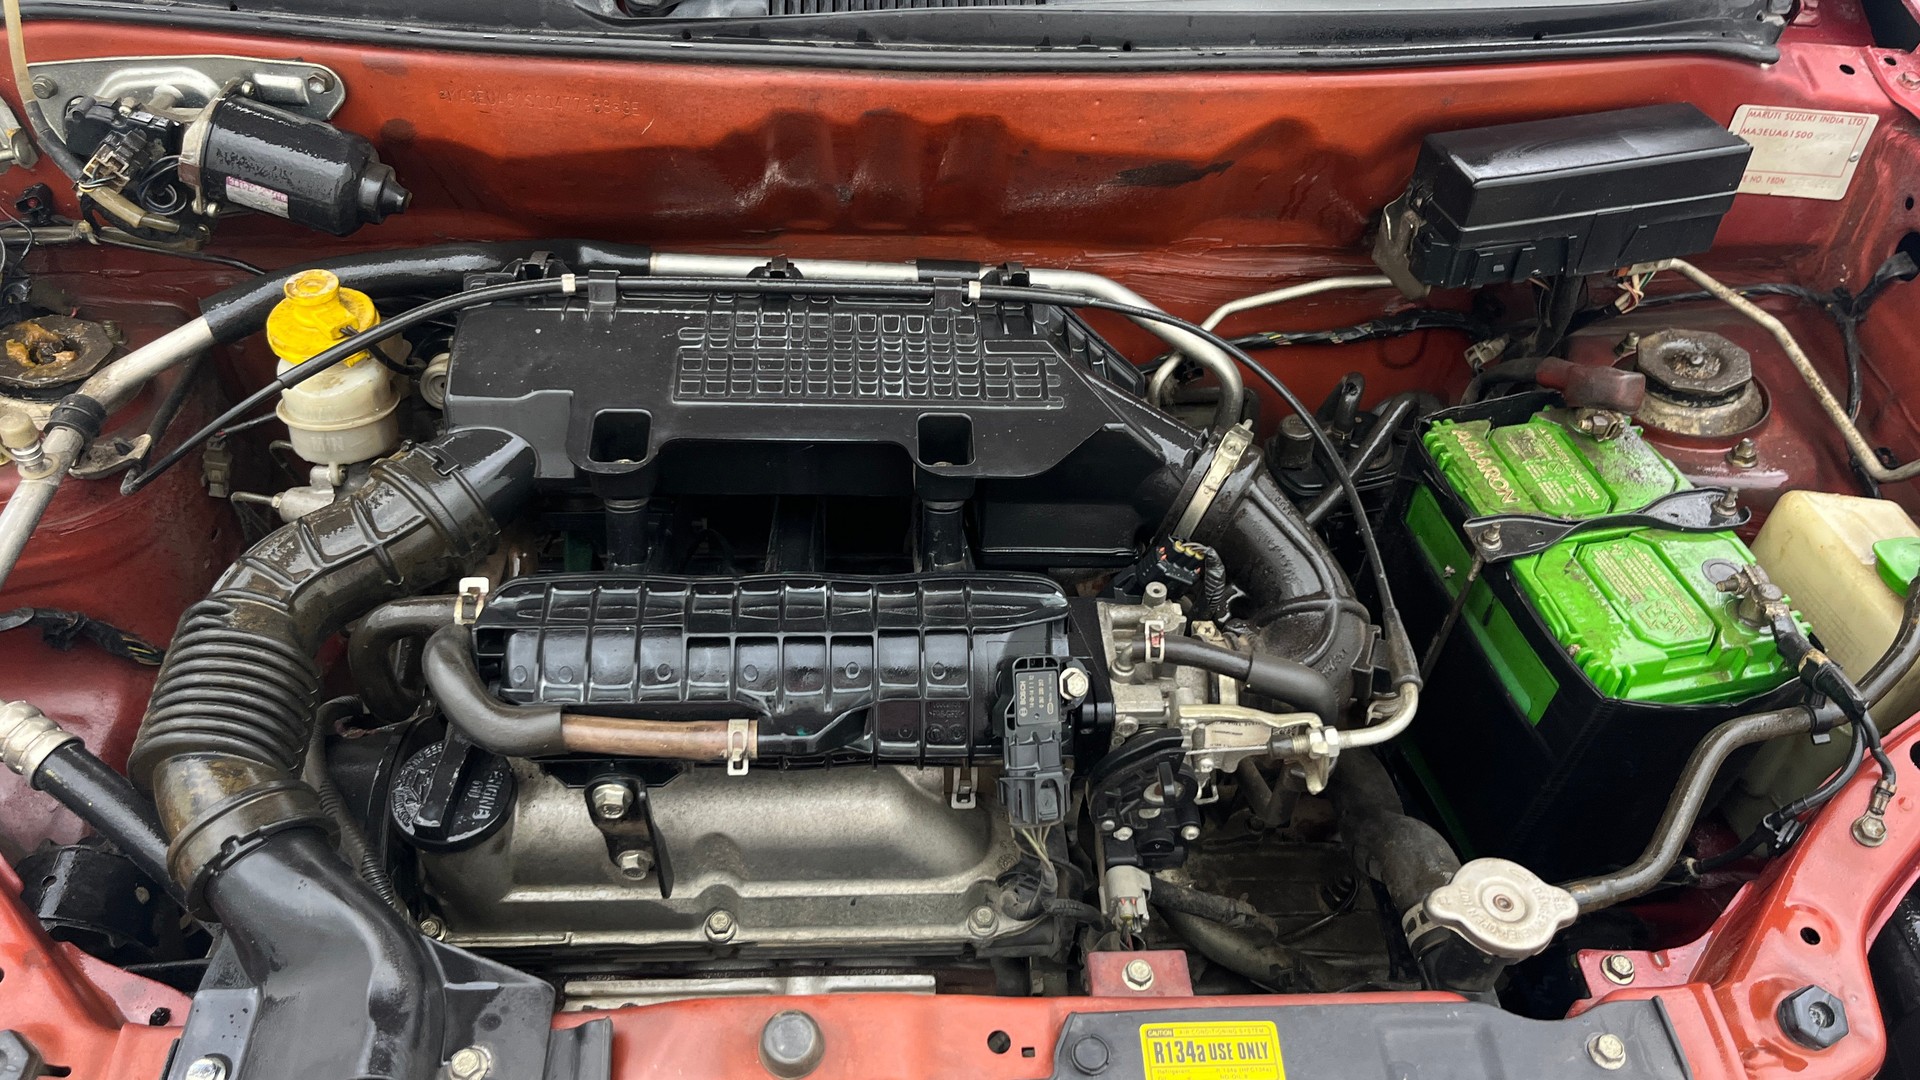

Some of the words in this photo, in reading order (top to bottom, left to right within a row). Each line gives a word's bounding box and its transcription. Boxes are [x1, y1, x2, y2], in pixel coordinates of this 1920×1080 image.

[1748, 110, 1782, 120] MARUTI
[1784, 112, 1817, 122] SUZUKI
[1819, 114, 1844, 124] INDIA
[1740, 127, 1814, 139] MA3EUA61S00
[1450, 428, 1522, 504] AMARON
[1019, 680, 1027, 706] BOSCH
[1147, 1029, 1173, 1037] CAUTION
[1153, 1040, 1206, 1064] R134a
[1207, 1042, 1234, 1061] USE
[1237, 1040, 1269, 1061] ONLY
